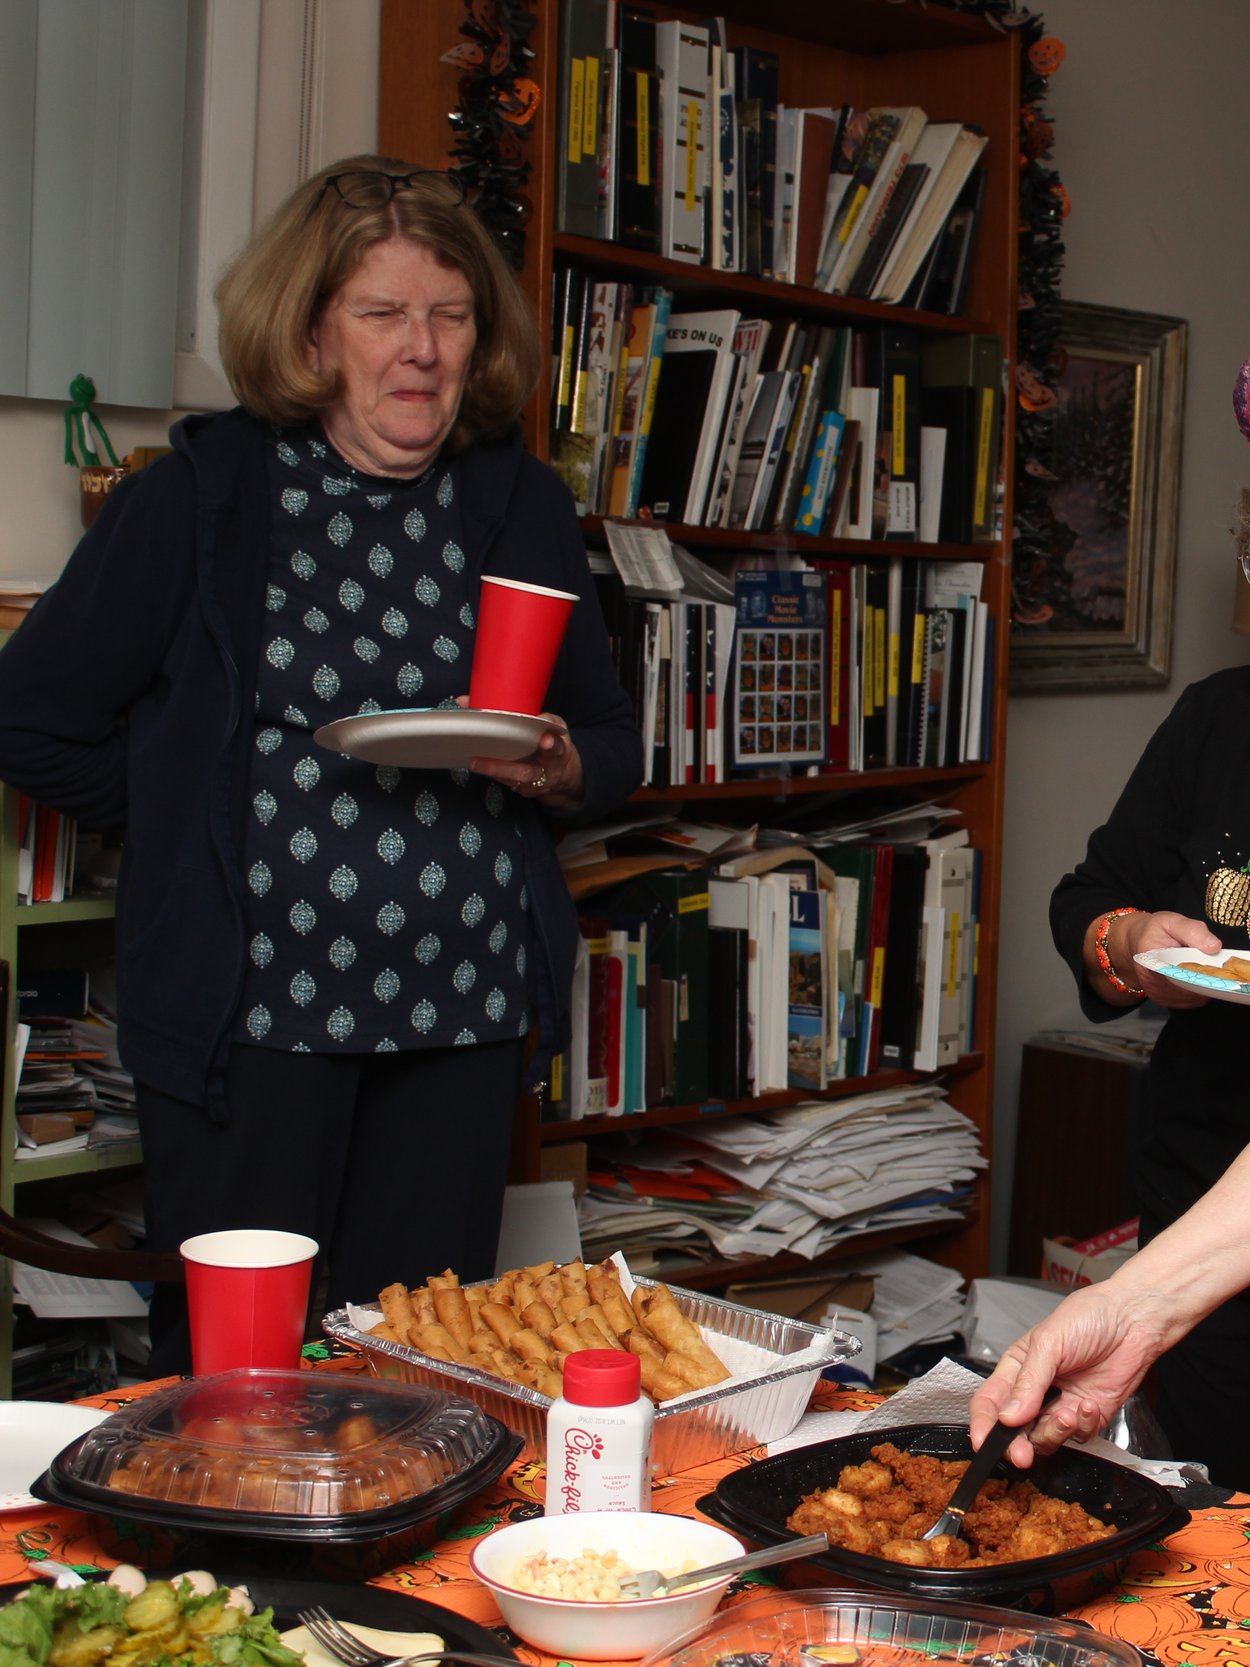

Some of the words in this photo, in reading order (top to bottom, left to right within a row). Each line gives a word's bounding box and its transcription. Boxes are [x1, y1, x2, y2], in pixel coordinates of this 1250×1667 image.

[691, 330, 707, 341] ON
[709, 333, 723, 347] US
[771, 594, 800, 603] Classic
[774, 605, 798, 614] Movie
[767, 615, 803, 624] Monsters
[561, 1428, 595, 1514] Chick-fil
